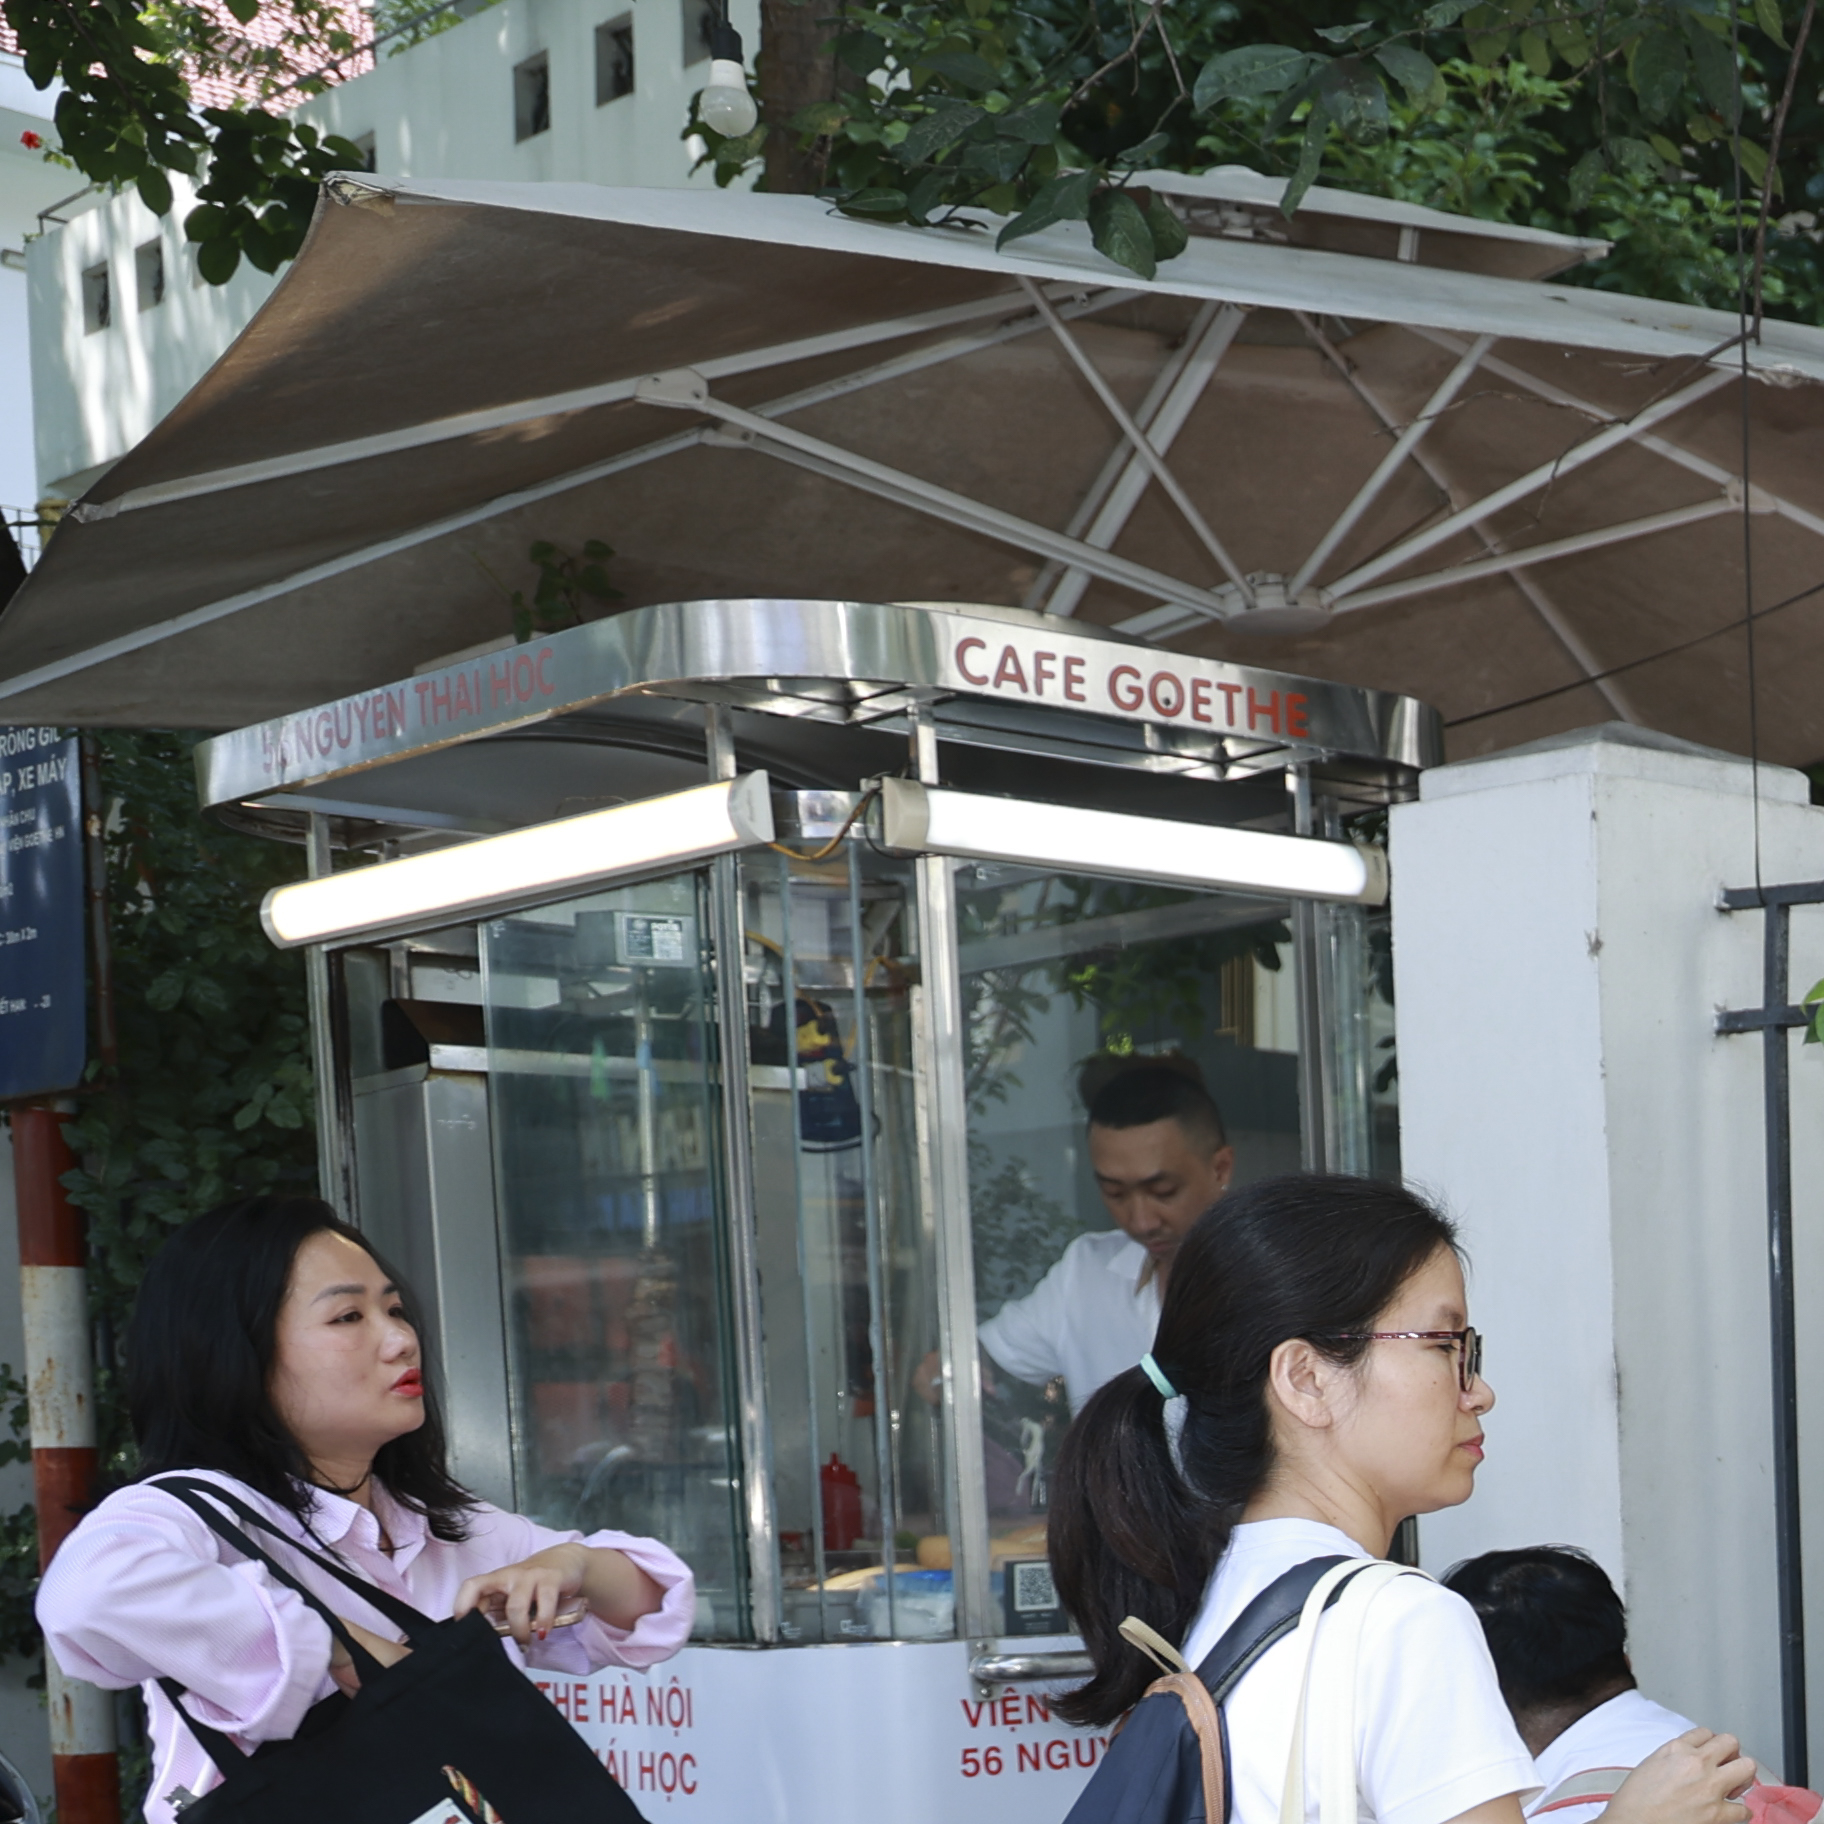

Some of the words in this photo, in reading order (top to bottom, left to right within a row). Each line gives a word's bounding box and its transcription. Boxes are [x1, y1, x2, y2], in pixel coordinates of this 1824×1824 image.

[294, 688, 406, 761] NGUYEN
[415, 668, 481, 728] THAI
[489, 646, 556, 710] HOC
[955, 636, 1087, 702] CAFE
[1108, 663, 1310, 738] GOETHE
[18, 765, 35, 792] XE
[37, 753, 67, 787] MÁY
[599, 1673, 638, 1725] HÀ
[646, 1675, 693, 1737] NỘI
[961, 1687, 1050, 1732] VIỆN
[638, 1751, 698, 1802] HỌC
[960, 1746, 1002, 1777] 56
